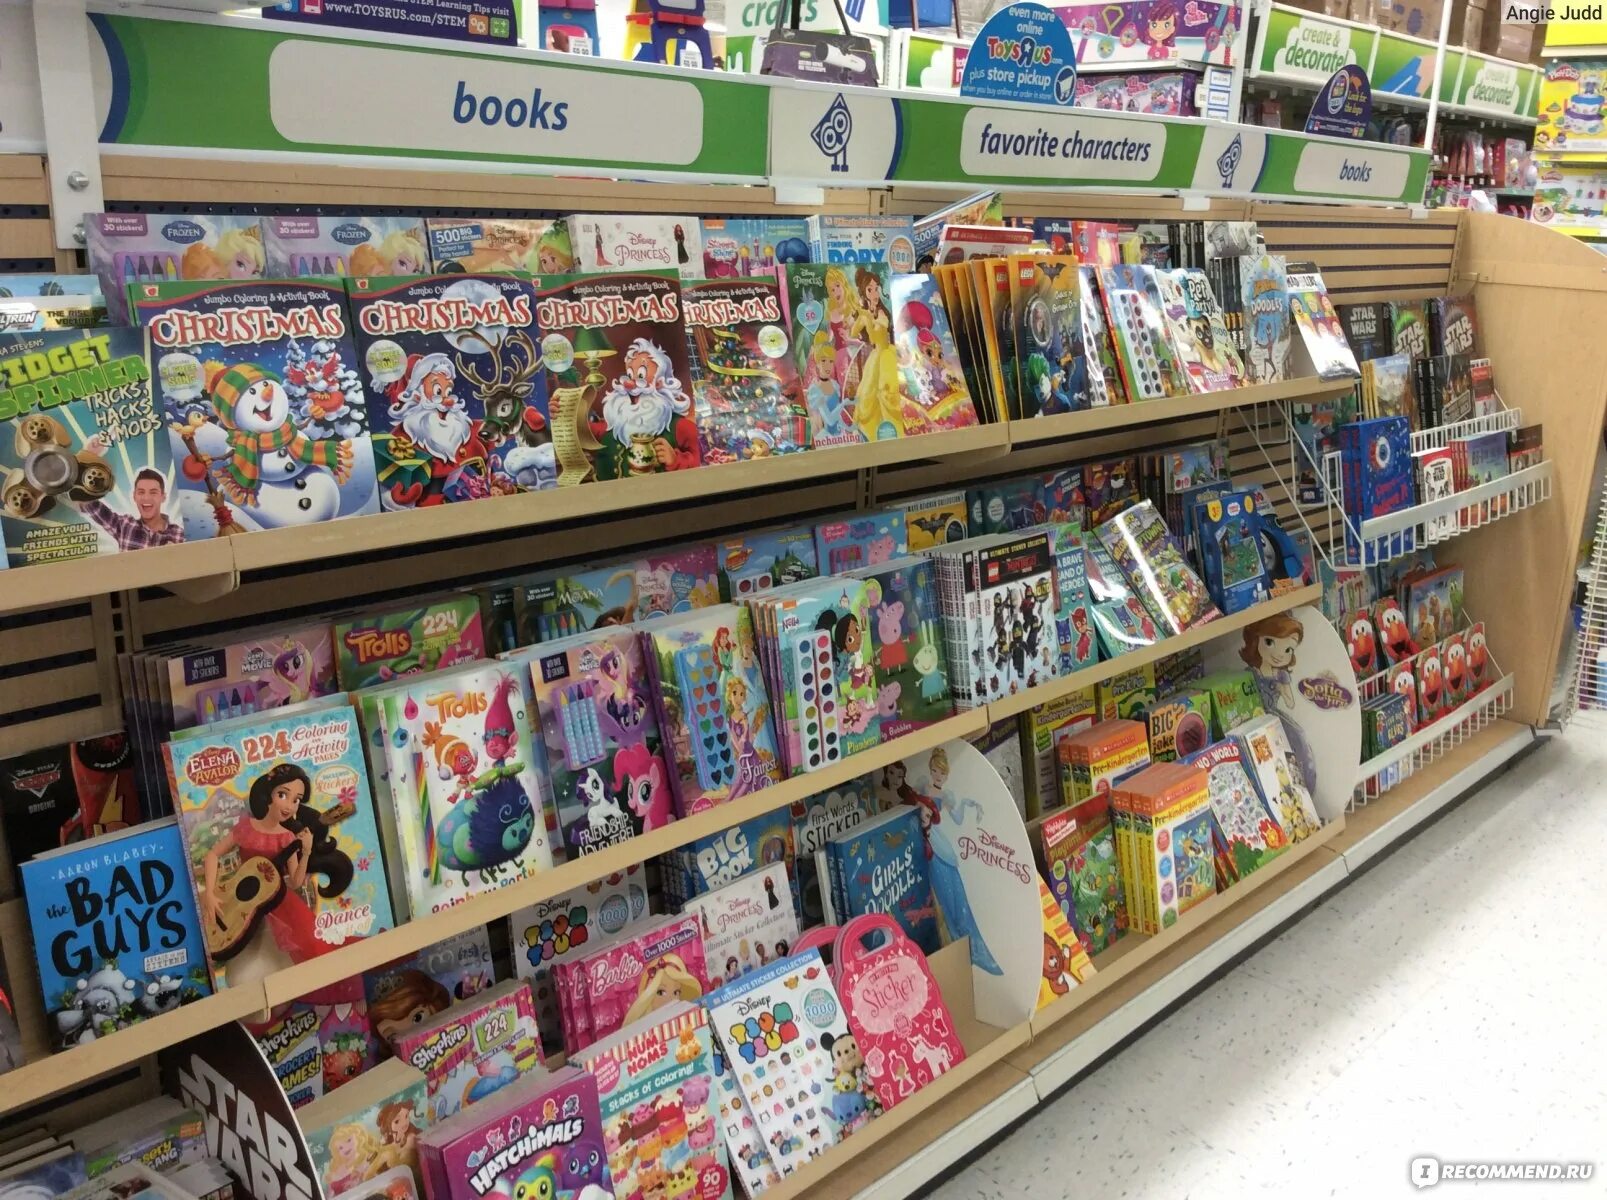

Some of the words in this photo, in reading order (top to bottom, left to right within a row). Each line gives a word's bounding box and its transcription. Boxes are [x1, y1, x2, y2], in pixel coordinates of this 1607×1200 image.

[325, 2, 467, 28] www.TOYSRUS.com/STEM
[474, 3, 490, 15] Tips
[492, 6, 510, 16] visit
[1009, 6, 1030, 18] even
[1032, 9, 1056, 23] more
[1017, 21, 1043, 36] online
[1302, 27, 1332, 45] create
[1332, 30, 1340, 47] &
[1285, 39, 1348, 73] decorate!
[969, 67, 986, 82] plus
[987, 68, 1015, 83] store
[1017, 69, 1051, 90] pickup
[453, 81, 568, 131] books
[980, 123, 1059, 158] favorite
[1062, 130, 1152, 162] characters
[1340, 158, 1372, 183] books
[167, 228, 200, 238] FROZEN
[336, 230, 367, 240] FROZEN
[436, 229, 461, 242] 500
[460, 227, 473, 236] BIG
[626, 232, 657, 248] Disney
[914, 229, 932, 245] 500
[614, 245, 672, 266] PRINCESS
[1020, 267, 1034, 279] LEGO
[204, 294, 232, 305] Jumbo
[233, 293, 268, 304] Coloring
[269, 293, 276, 302] &
[276, 291, 309, 302] Activity
[308, 290, 331, 300] Book
[408, 286, 433, 297] Jumbo
[501, 281, 522, 291] Book
[573, 284, 594, 295] Jumbo
[594, 284, 621, 294] Coloring
[622, 284, 628, 292] &
[628, 282, 652, 293] Activity
[652, 280, 670, 291] Book
[755, 286, 770, 296] Book
[1188, 279, 1208, 301] Pet
[47, 310, 67, 318] THE
[360, 293, 533, 336] CHRISTMAS
[537, 292, 679, 330] CHRISTMAS
[683, 297, 781, 328] HRISTMAS
[1251, 299, 1284, 317] DOODLES
[1350, 306, 1376, 321] STAR
[151, 303, 347, 347] CHRISTMAS
[1350, 320, 1377, 336] WARS
[1394, 321, 1425, 352] STAR
[1444, 316, 1472, 345] STAR
[10, 338, 45, 353] STEVENS
[1444, 329, 1473, 356] WARS
[0, 334, 111, 386] IDGET
[0, 354, 149, 420] SPINNER
[96, 397, 154, 426] HACKS
[117, 414, 162, 443] MODS
[814, 433, 861, 448] nchanting
[23, 538, 68, 550] FRIENDS
[70, 533, 97, 543] WITH
[26, 528, 61, 539] AMAZE
[62, 523, 91, 533] YOUR
[27, 545, 98, 562] SPECTACULAR
[1057, 558, 1062, 568] A
[1062, 552, 1083, 566] BRAVE
[1076, 564, 1085, 575] OF
[558, 588, 604, 606] MOANA
[423, 610, 458, 635] 224
[347, 632, 410, 663] Trolls
[241, 659, 273, 674] MOVIE
[1303, 680, 1343, 699] Sofia
[426, 692, 488, 723] Trolls
[1325, 694, 1348, 709] First
[292, 720, 348, 742] Coloring
[1151, 709, 1174, 737] BIG
[243, 730, 292, 764] 224
[292, 737, 348, 760] Activity
[1152, 733, 1175, 756] joke
[1212, 742, 1239, 763] WORLD
[189, 751, 236, 773] ELENA
[314, 752, 340, 764] PAGES
[739, 751, 778, 784] Fairest
[1092, 746, 1148, 775] Pre-Kindergarten
[195, 766, 239, 784] AVALOR
[812, 813, 830, 826] First
[831, 802, 855, 818] Words
[1154, 792, 1208, 826] Pre-Kindergarten
[579, 811, 629, 847] FRIENDSHIP
[697, 826, 749, 878] BIG
[977, 827, 1016, 859] Disney
[58, 858, 98, 880] AARON
[104, 844, 156, 865] BLABEY
[872, 842, 914, 897] GIRLS'
[958, 836, 1031, 884] PRINCESS
[47, 904, 71, 919] the
[65, 860, 174, 927] BAD
[316, 904, 370, 930] Dance
[536, 898, 571, 918] Disney
[600, 907, 628, 923] 1000
[717, 901, 764, 932] PRINCESS
[51, 900, 187, 977] GUYS
[645, 948, 658, 959] Over
[656, 937, 676, 952] 1000
[676, 930, 698, 945] Stickers
[590, 953, 644, 997] Barbie
[721, 976, 757, 1002] ULTIMATE
[758, 966, 784, 988] STICKER
[785, 953, 813, 976] COLLECTION
[732, 995, 772, 1017] Disney
[862, 974, 916, 1018] Sticker
[805, 1001, 836, 1018] 1000
[484, 1012, 508, 1042] 224
[412, 1024, 467, 1069] Shopkins
[627, 1035, 659, 1061] NUM
[627, 1041, 668, 1077] NOMS
[608, 1087, 640, 1112] Stacks
[642, 1081, 652, 1093] of
[178, 1053, 313, 1198] STAR
[703, 1171, 721, 1188] 90
